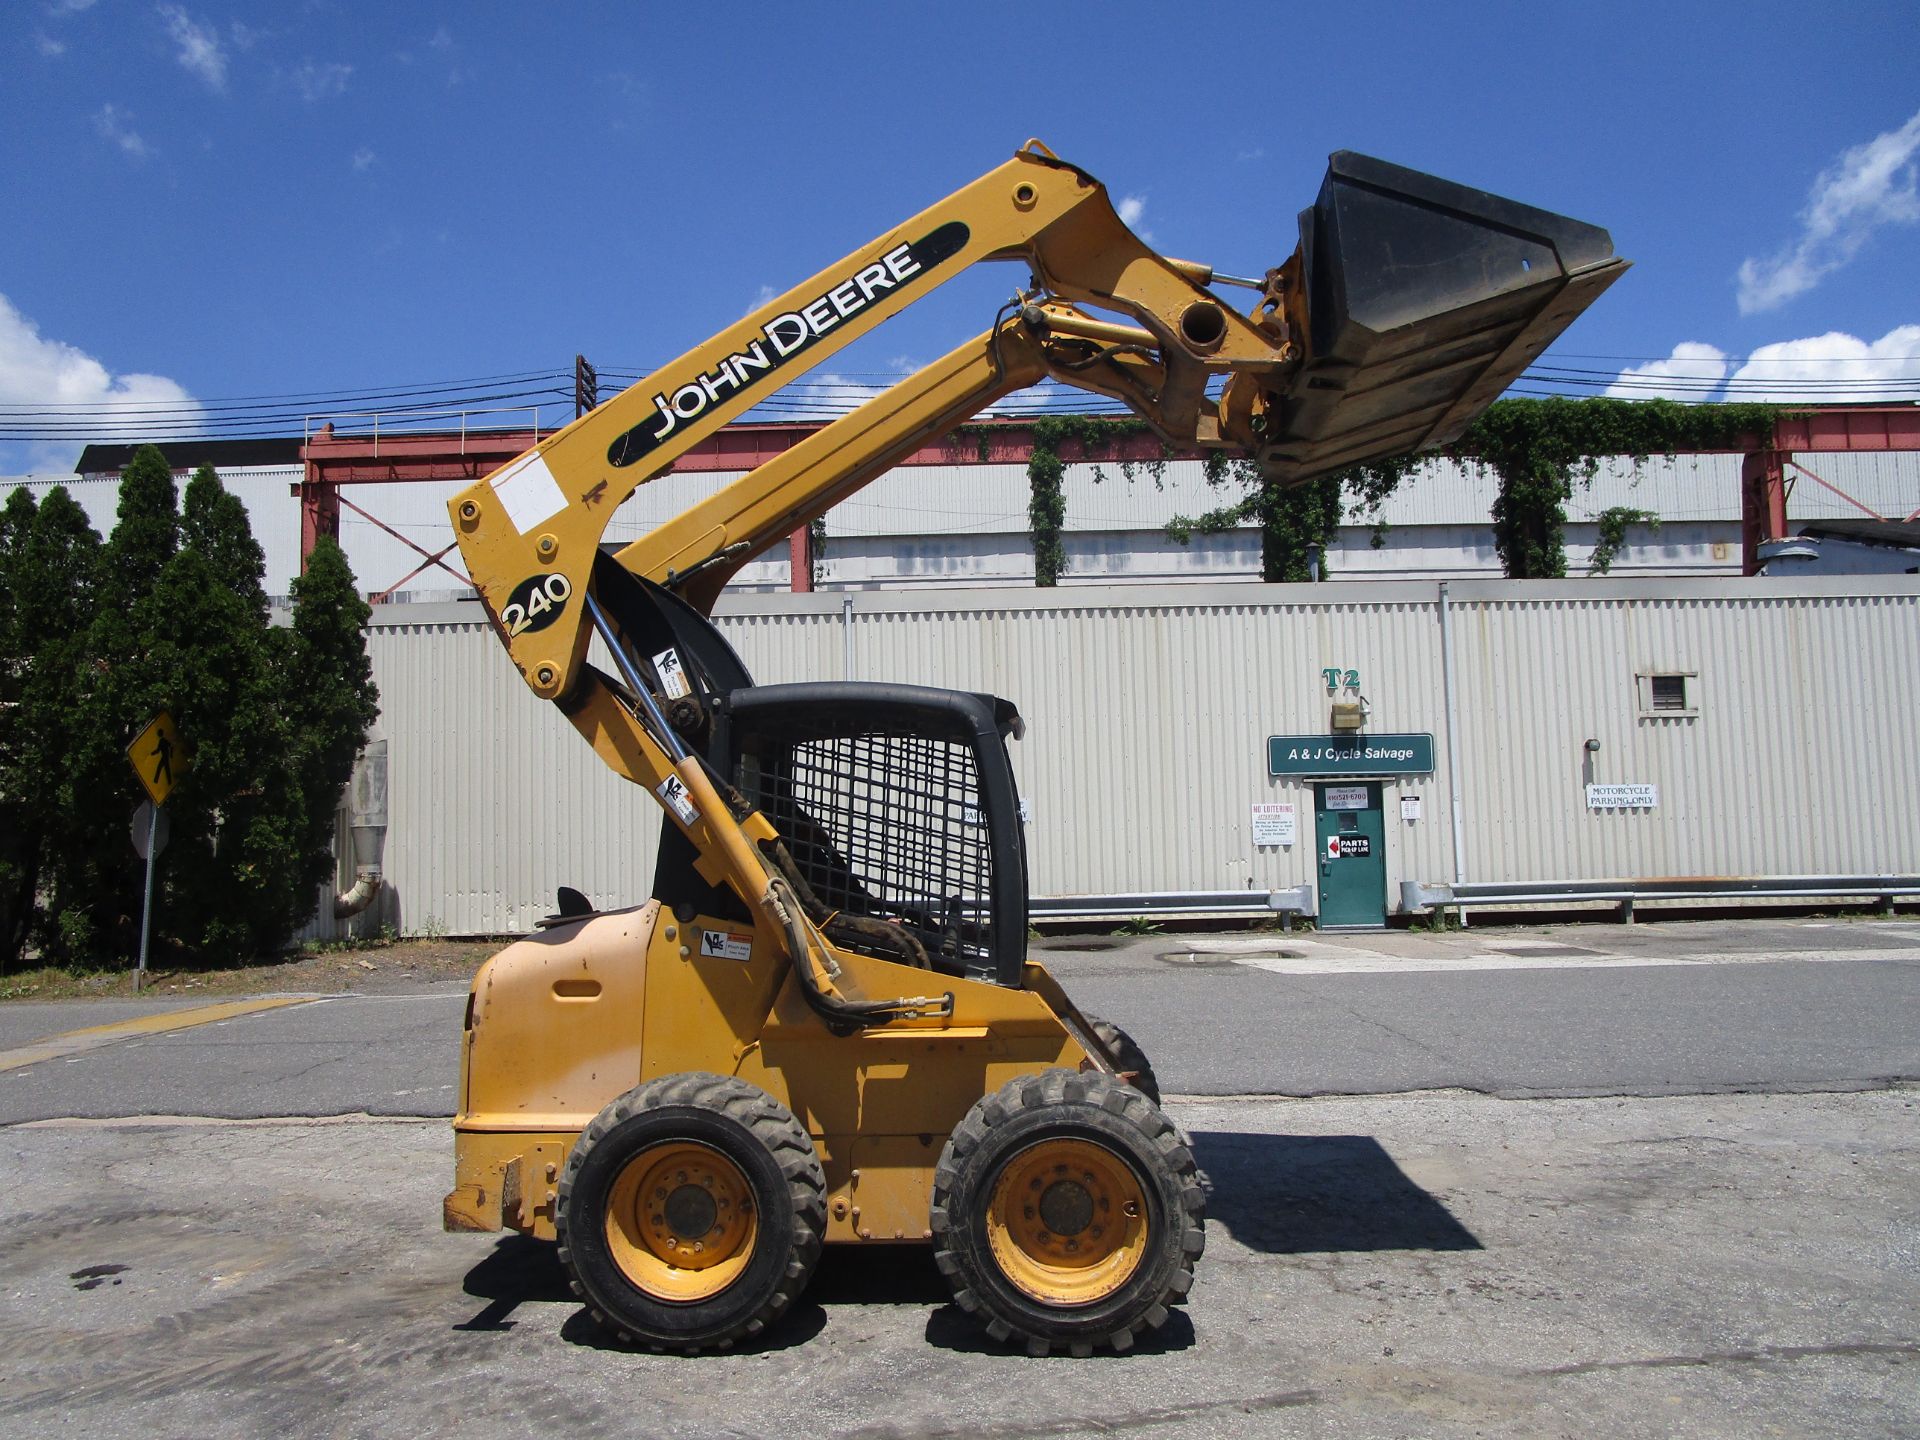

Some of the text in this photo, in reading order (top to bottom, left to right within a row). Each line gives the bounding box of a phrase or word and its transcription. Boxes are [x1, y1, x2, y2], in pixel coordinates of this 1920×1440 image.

[653, 243, 921, 439] JOHN DEERE
[502, 573, 571, 637] 240
[1322, 668, 1360, 689] T2
[1288, 748, 1414, 761] A & J Cycle Salvage
[1593, 787, 1650, 795] MOTORCYCLE
[1253, 805, 1293, 813] NO LOITERING
[1341, 839, 1368, 847] PARTS
